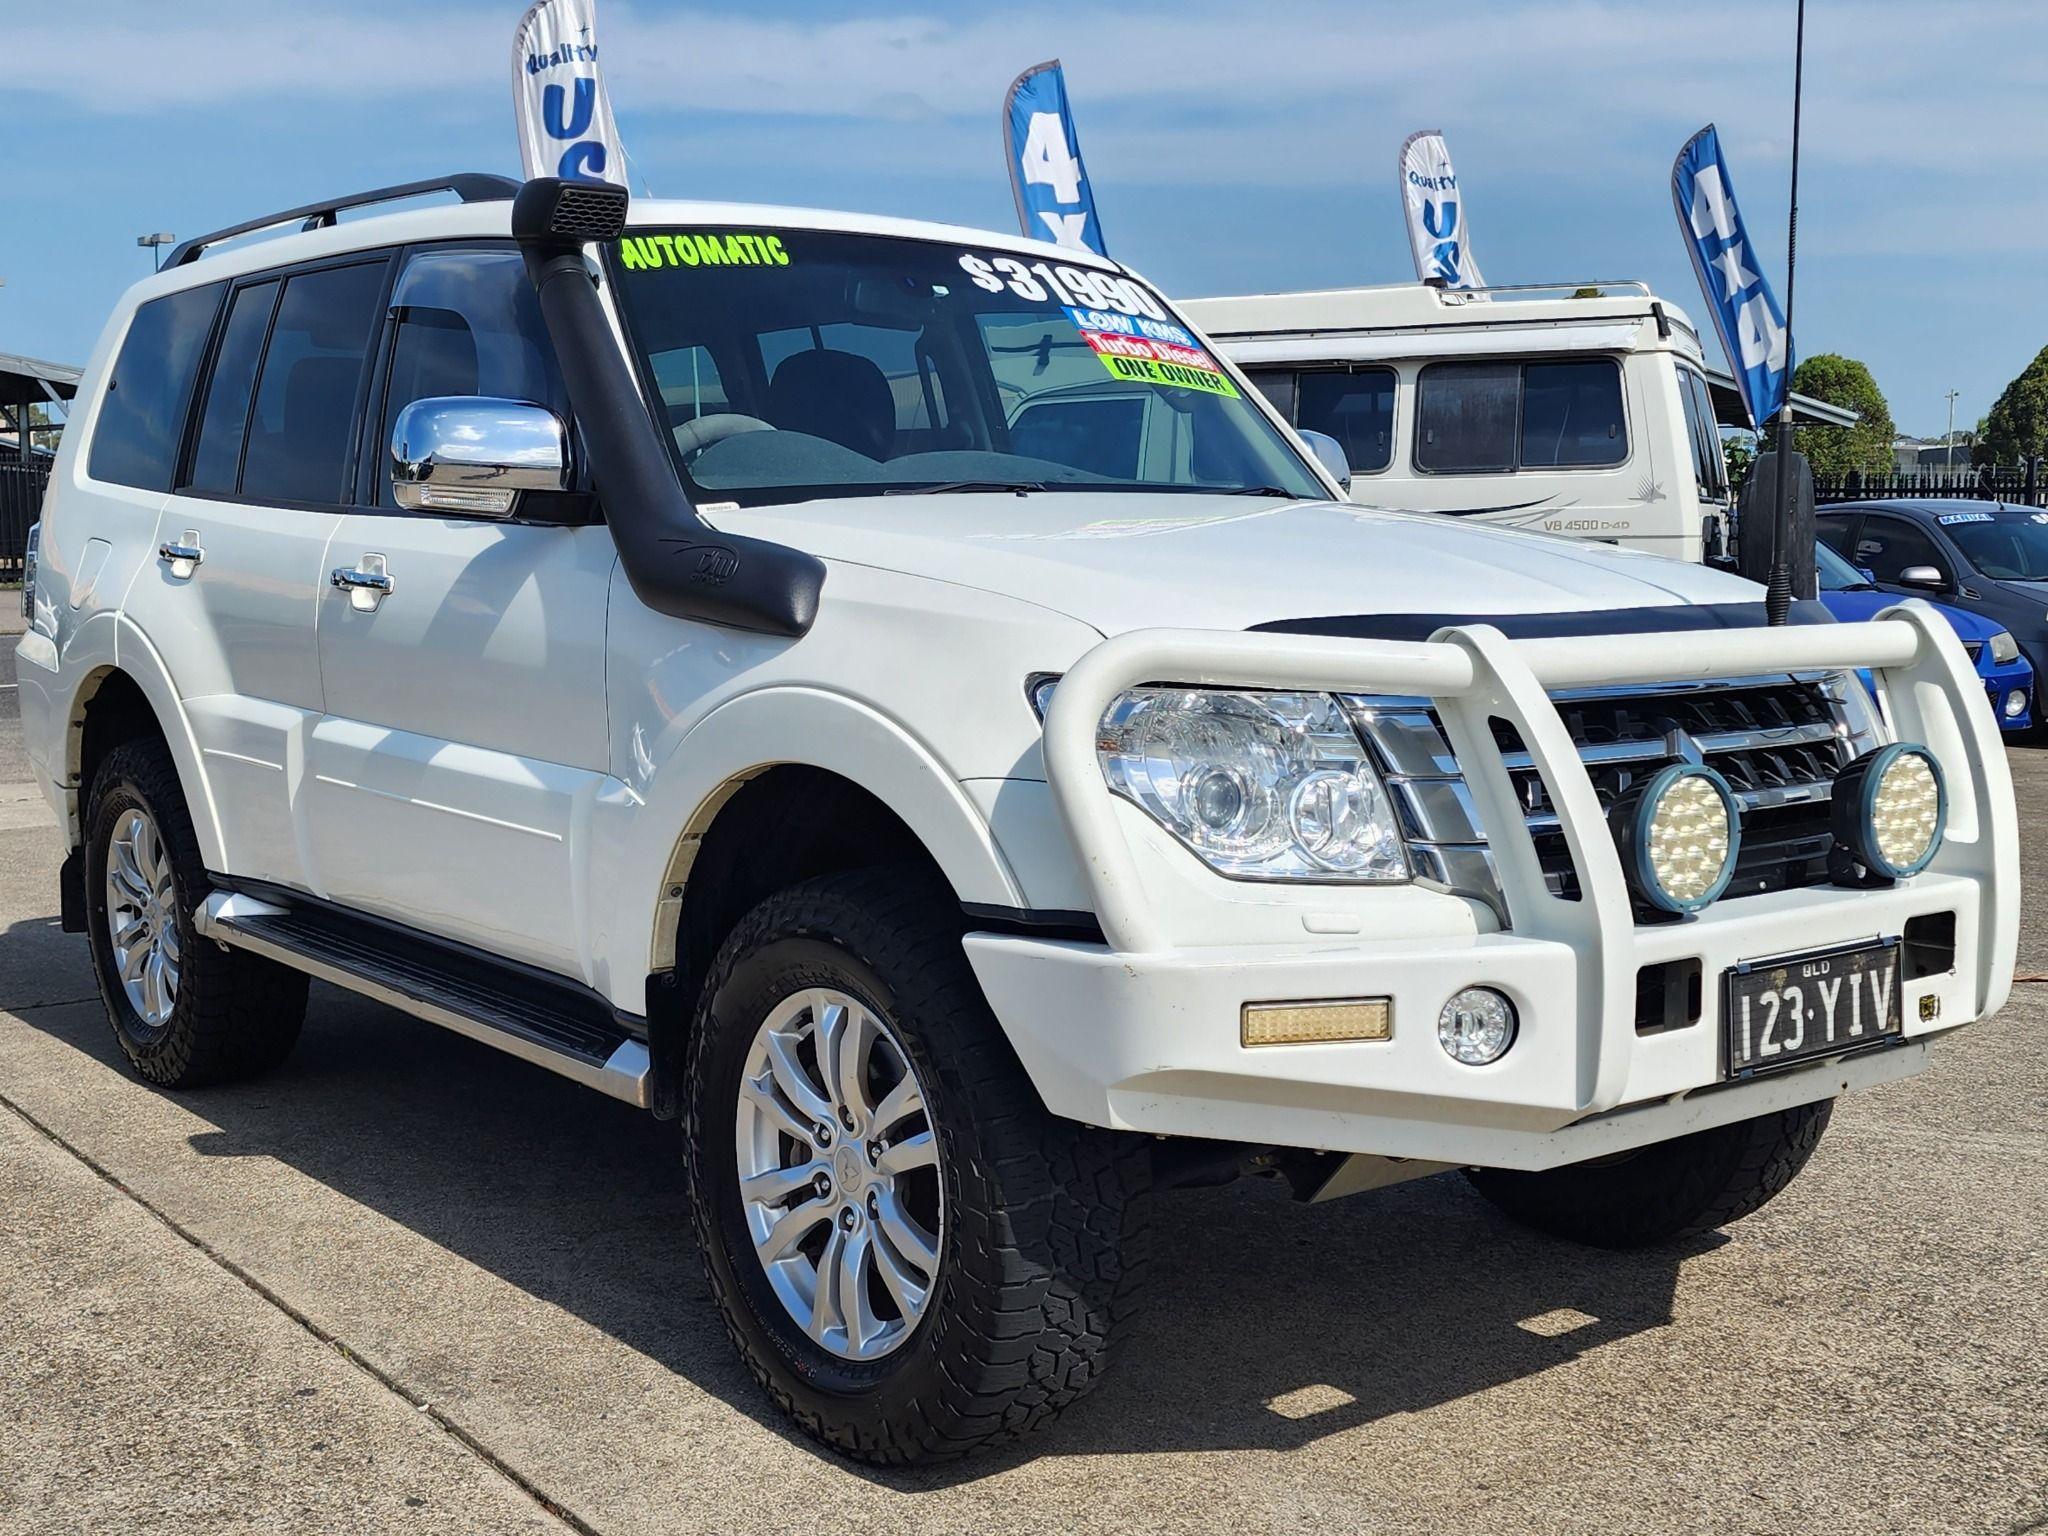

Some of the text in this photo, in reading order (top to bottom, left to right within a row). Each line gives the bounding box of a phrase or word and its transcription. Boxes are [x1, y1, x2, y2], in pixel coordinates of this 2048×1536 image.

[527, 43, 598, 76] Quality
[1409, 170, 1457, 192] Qualty
[621, 235, 790, 270] AUTOMATIC
[958, 254, 1168, 322] $31990
[1072, 309, 1194, 348] LOW KMS
[1086, 333, 1213, 370] Turbo Diesel
[1113, 357, 1226, 392] ONE OWNER
[1544, 519, 1630, 531] V8 4500 D-4D
[1803, 961, 1831, 978] QLD
